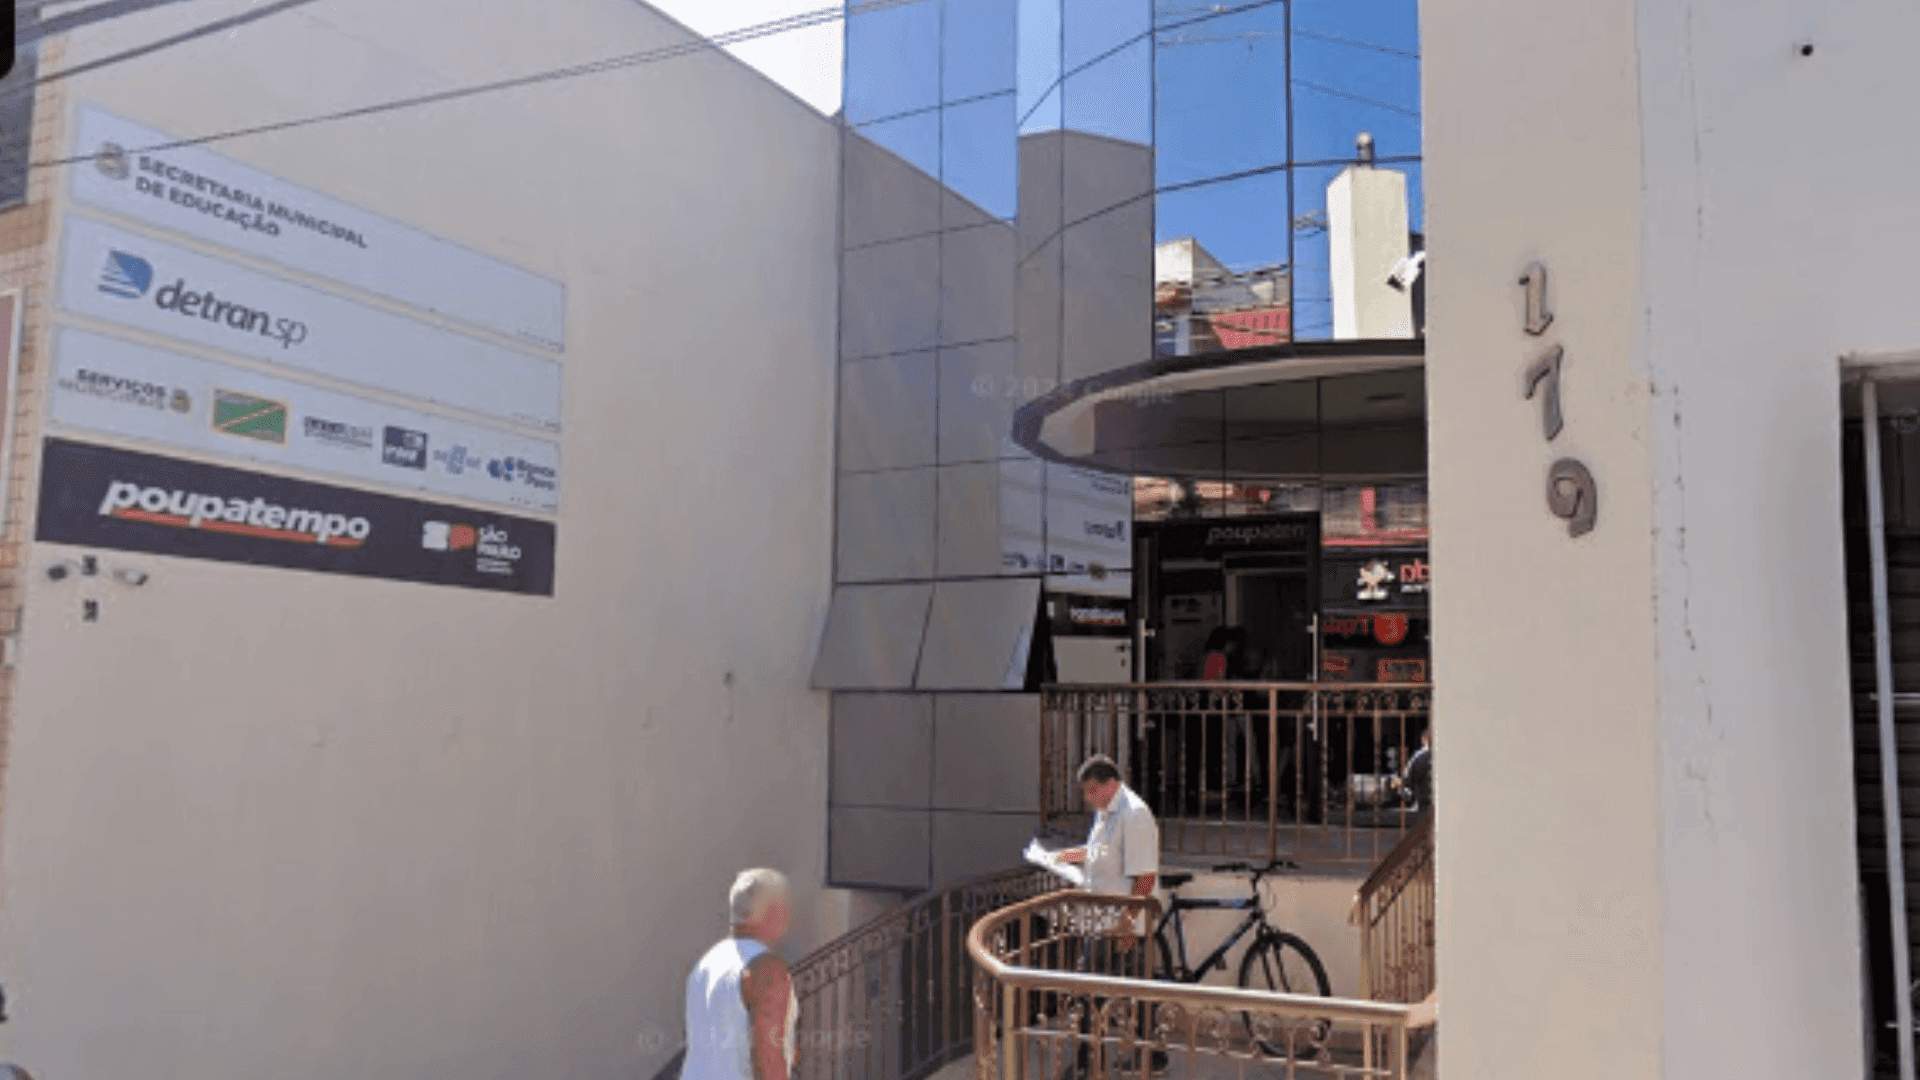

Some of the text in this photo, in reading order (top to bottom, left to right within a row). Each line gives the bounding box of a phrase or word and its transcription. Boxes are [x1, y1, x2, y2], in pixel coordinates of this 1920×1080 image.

[135, 175, 281, 237] DE EDUCAÇÃO
[138, 155, 369, 249] SECRETARIA MUNICIPAL
[1518, 259, 1597, 538] 179
[97, 479, 371, 544] poupatempo
